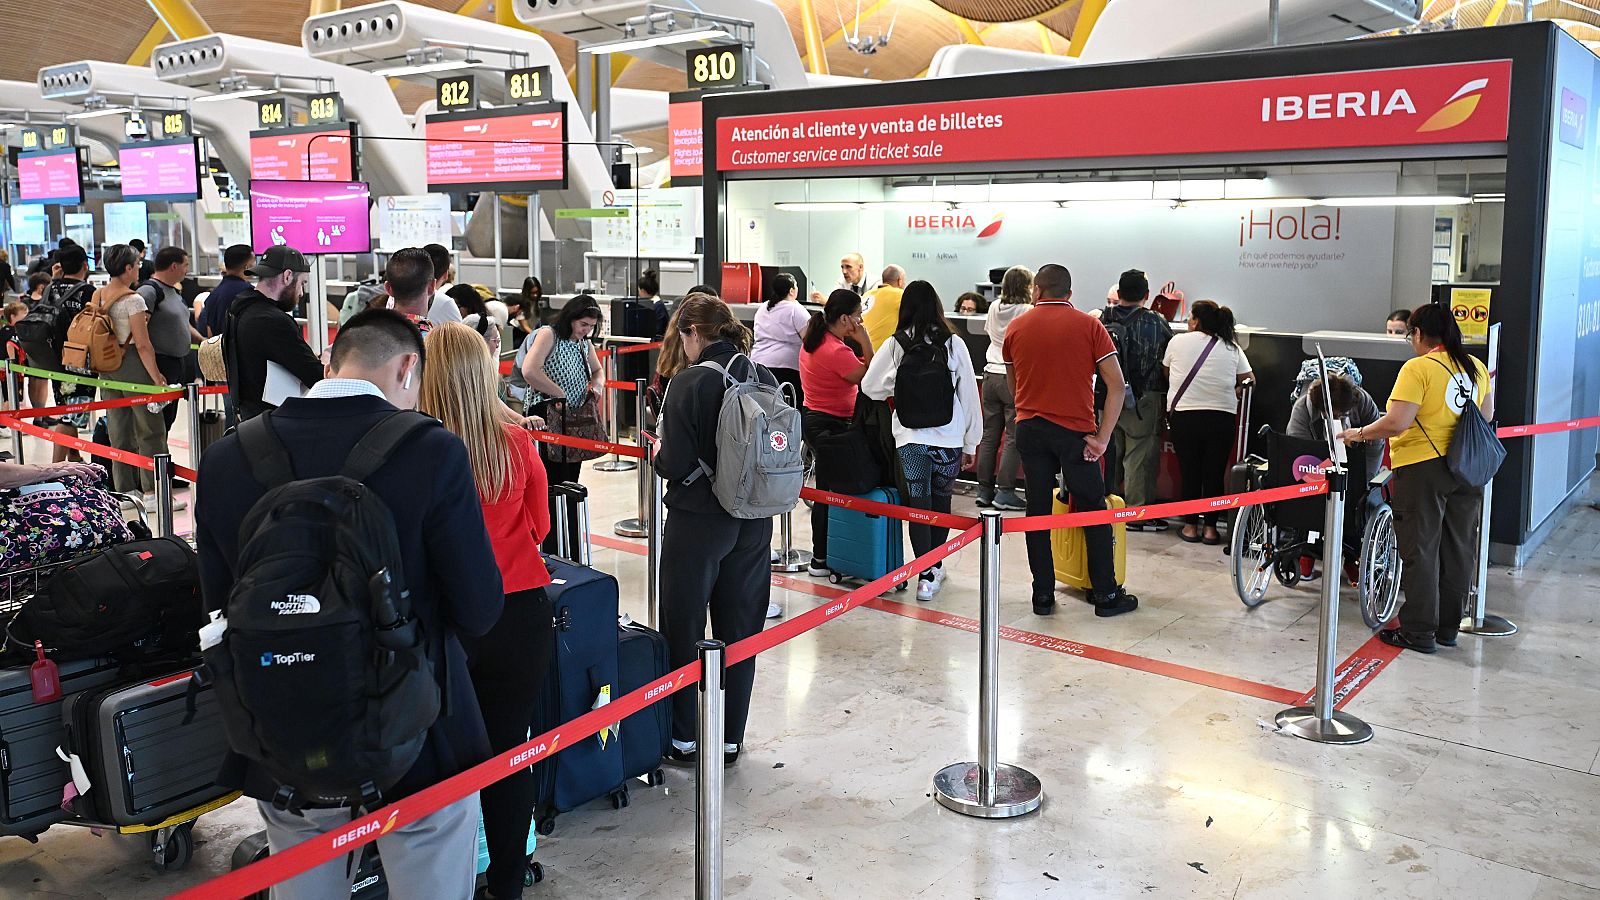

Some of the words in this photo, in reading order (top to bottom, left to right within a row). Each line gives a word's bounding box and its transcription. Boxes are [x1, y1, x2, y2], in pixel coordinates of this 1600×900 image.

[694, 51, 736, 82] 810
[510, 72, 542, 98] 811
[441, 80, 469, 106] 812
[310, 97, 334, 120] 813
[1261, 88, 1417, 123] IBERIA
[261, 103, 282, 124] 814
[731, 124, 789, 142] Atención
[792, 122, 805, 138] al
[807, 121, 856, 138] cliente
[858, 123, 868, 139] y
[871, 118, 914, 135] venta
[917, 114, 937, 132] de
[940, 111, 1003, 131] billetes
[731, 149, 790, 165] Customer
[792, 146, 838, 163] service
[840, 144, 867, 160] and
[869, 142, 910, 159] ticket
[912, 140, 943, 158] sale
[908, 215, 976, 229] IBERIA
[1240, 206, 1341, 247] ¡Hola!
[1253, 252, 1268, 262] qué
[1269, 251, 1306, 262] podemos
[1306, 252, 1345, 263] ayudarle?
[1239, 261, 1255, 269] How
[1283, 261, 1299, 270] help
[1298, 463, 1326, 475] mitie
[1299, 484, 1319, 492] IBERIA
[826, 496, 845, 504] IBERIA
[1210, 498, 1231, 507] IBERIA
[909, 512, 930, 521] IBERIA
[1114, 510, 1137, 518] IBERIA
[287, 594, 307, 602] THE
[270, 601, 305, 610] NORTH
[825, 602, 843, 617] IBERIA
[1039, 641, 1084, 654] TURNO
[273, 652, 316, 666] TopTier
[644, 680, 673, 701] IBERIA
[509, 742, 547, 768] IBERIA
[331, 820, 381, 849] IBERIA
